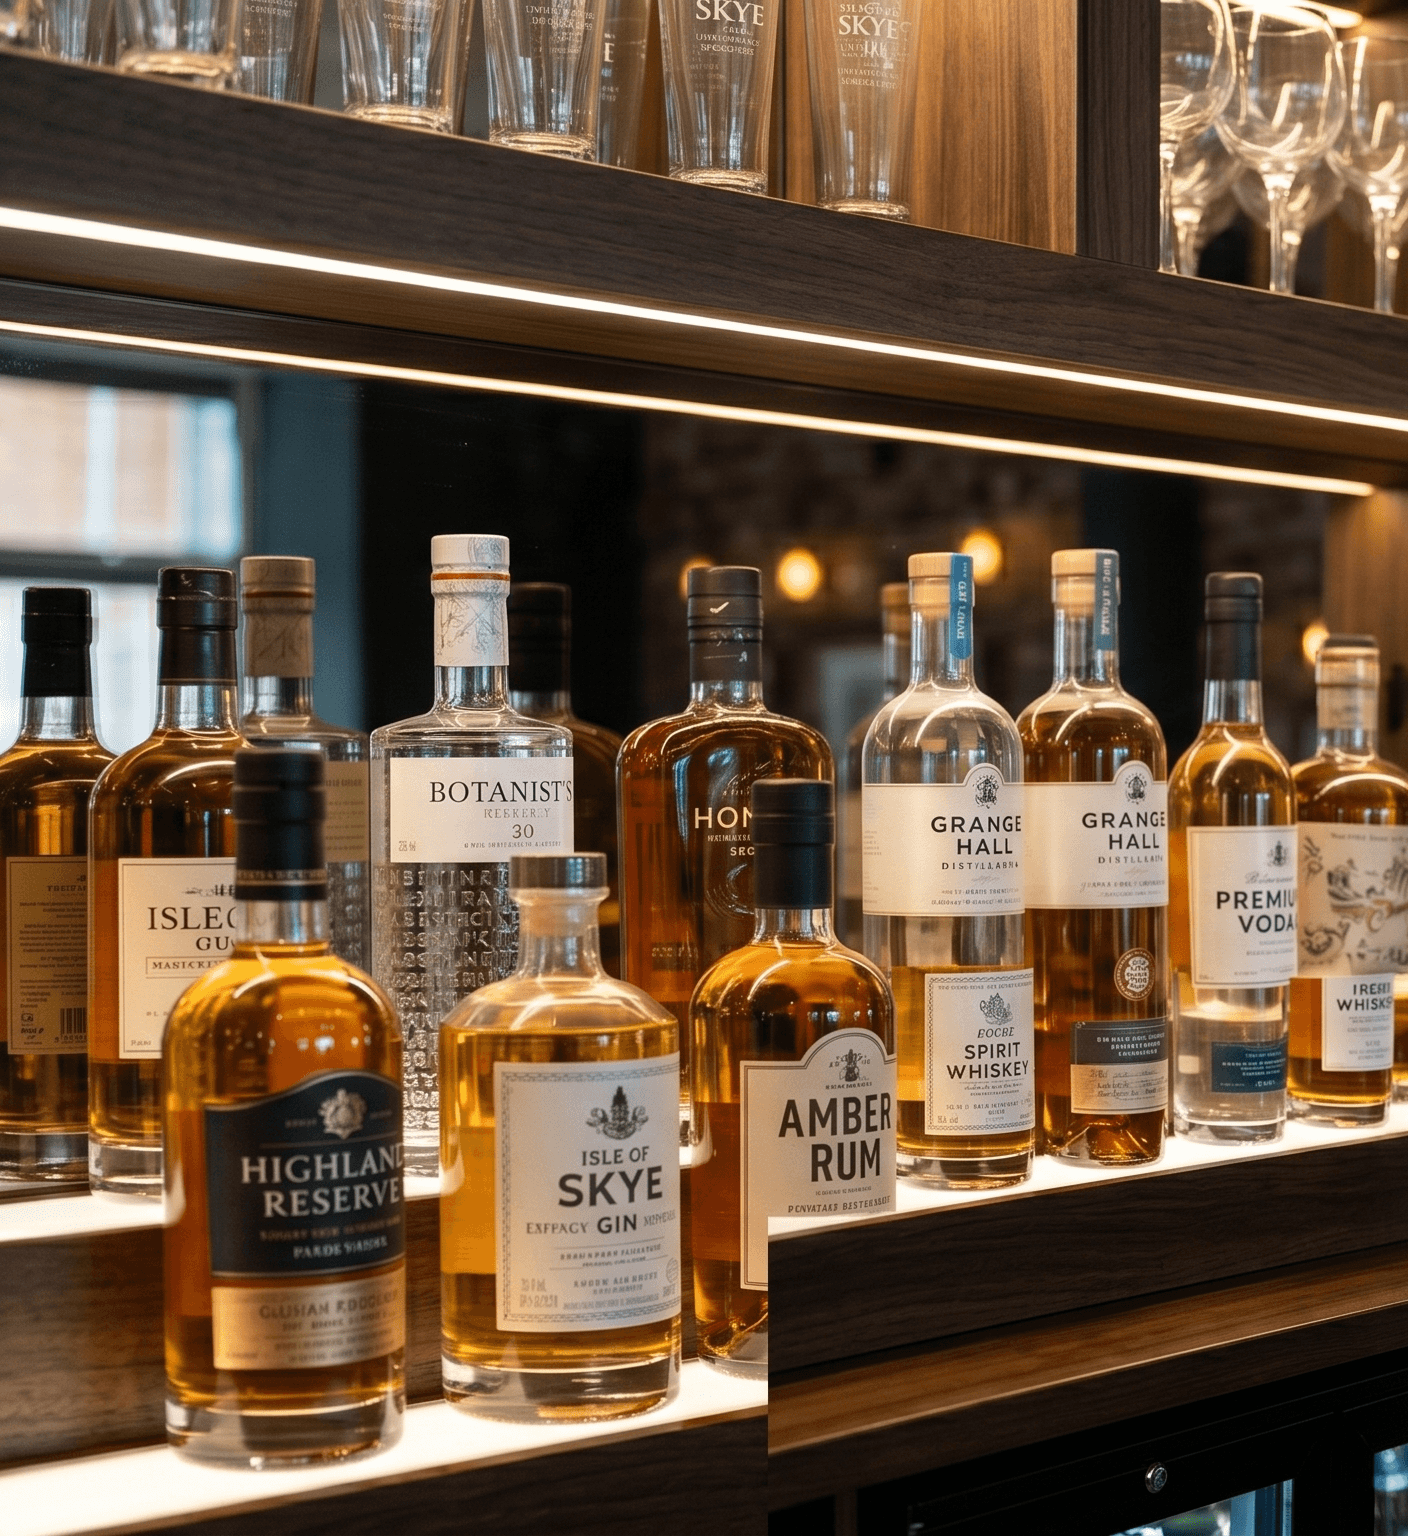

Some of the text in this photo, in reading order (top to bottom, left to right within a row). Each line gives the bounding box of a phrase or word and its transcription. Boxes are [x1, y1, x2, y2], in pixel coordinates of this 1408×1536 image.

[695, 0, 764, 27] SKYE
[838, 14, 899, 40] SKYE
[429, 780, 572, 803] BOTANIST'S
[930, 815, 1021, 833] GRANGE
[1081, 811, 1166, 829] GRANGE
[512, 823, 534, 839] 30
[1108, 833, 1160, 850] HALL
[956, 838, 1013, 856] HALL
[964, 1041, 1021, 1060] SPIRIT
[946, 1060, 1029, 1080] WHISKEY
[778, 1092, 891, 1138] AMBER
[581, 1146, 650, 1167] ISLE OF
[811, 1138, 881, 1183] RUM
[557, 1165, 663, 1208] SKYE
[262, 1177, 400, 1218] RESERVE
[596, 1213, 637, 1235] GIN
